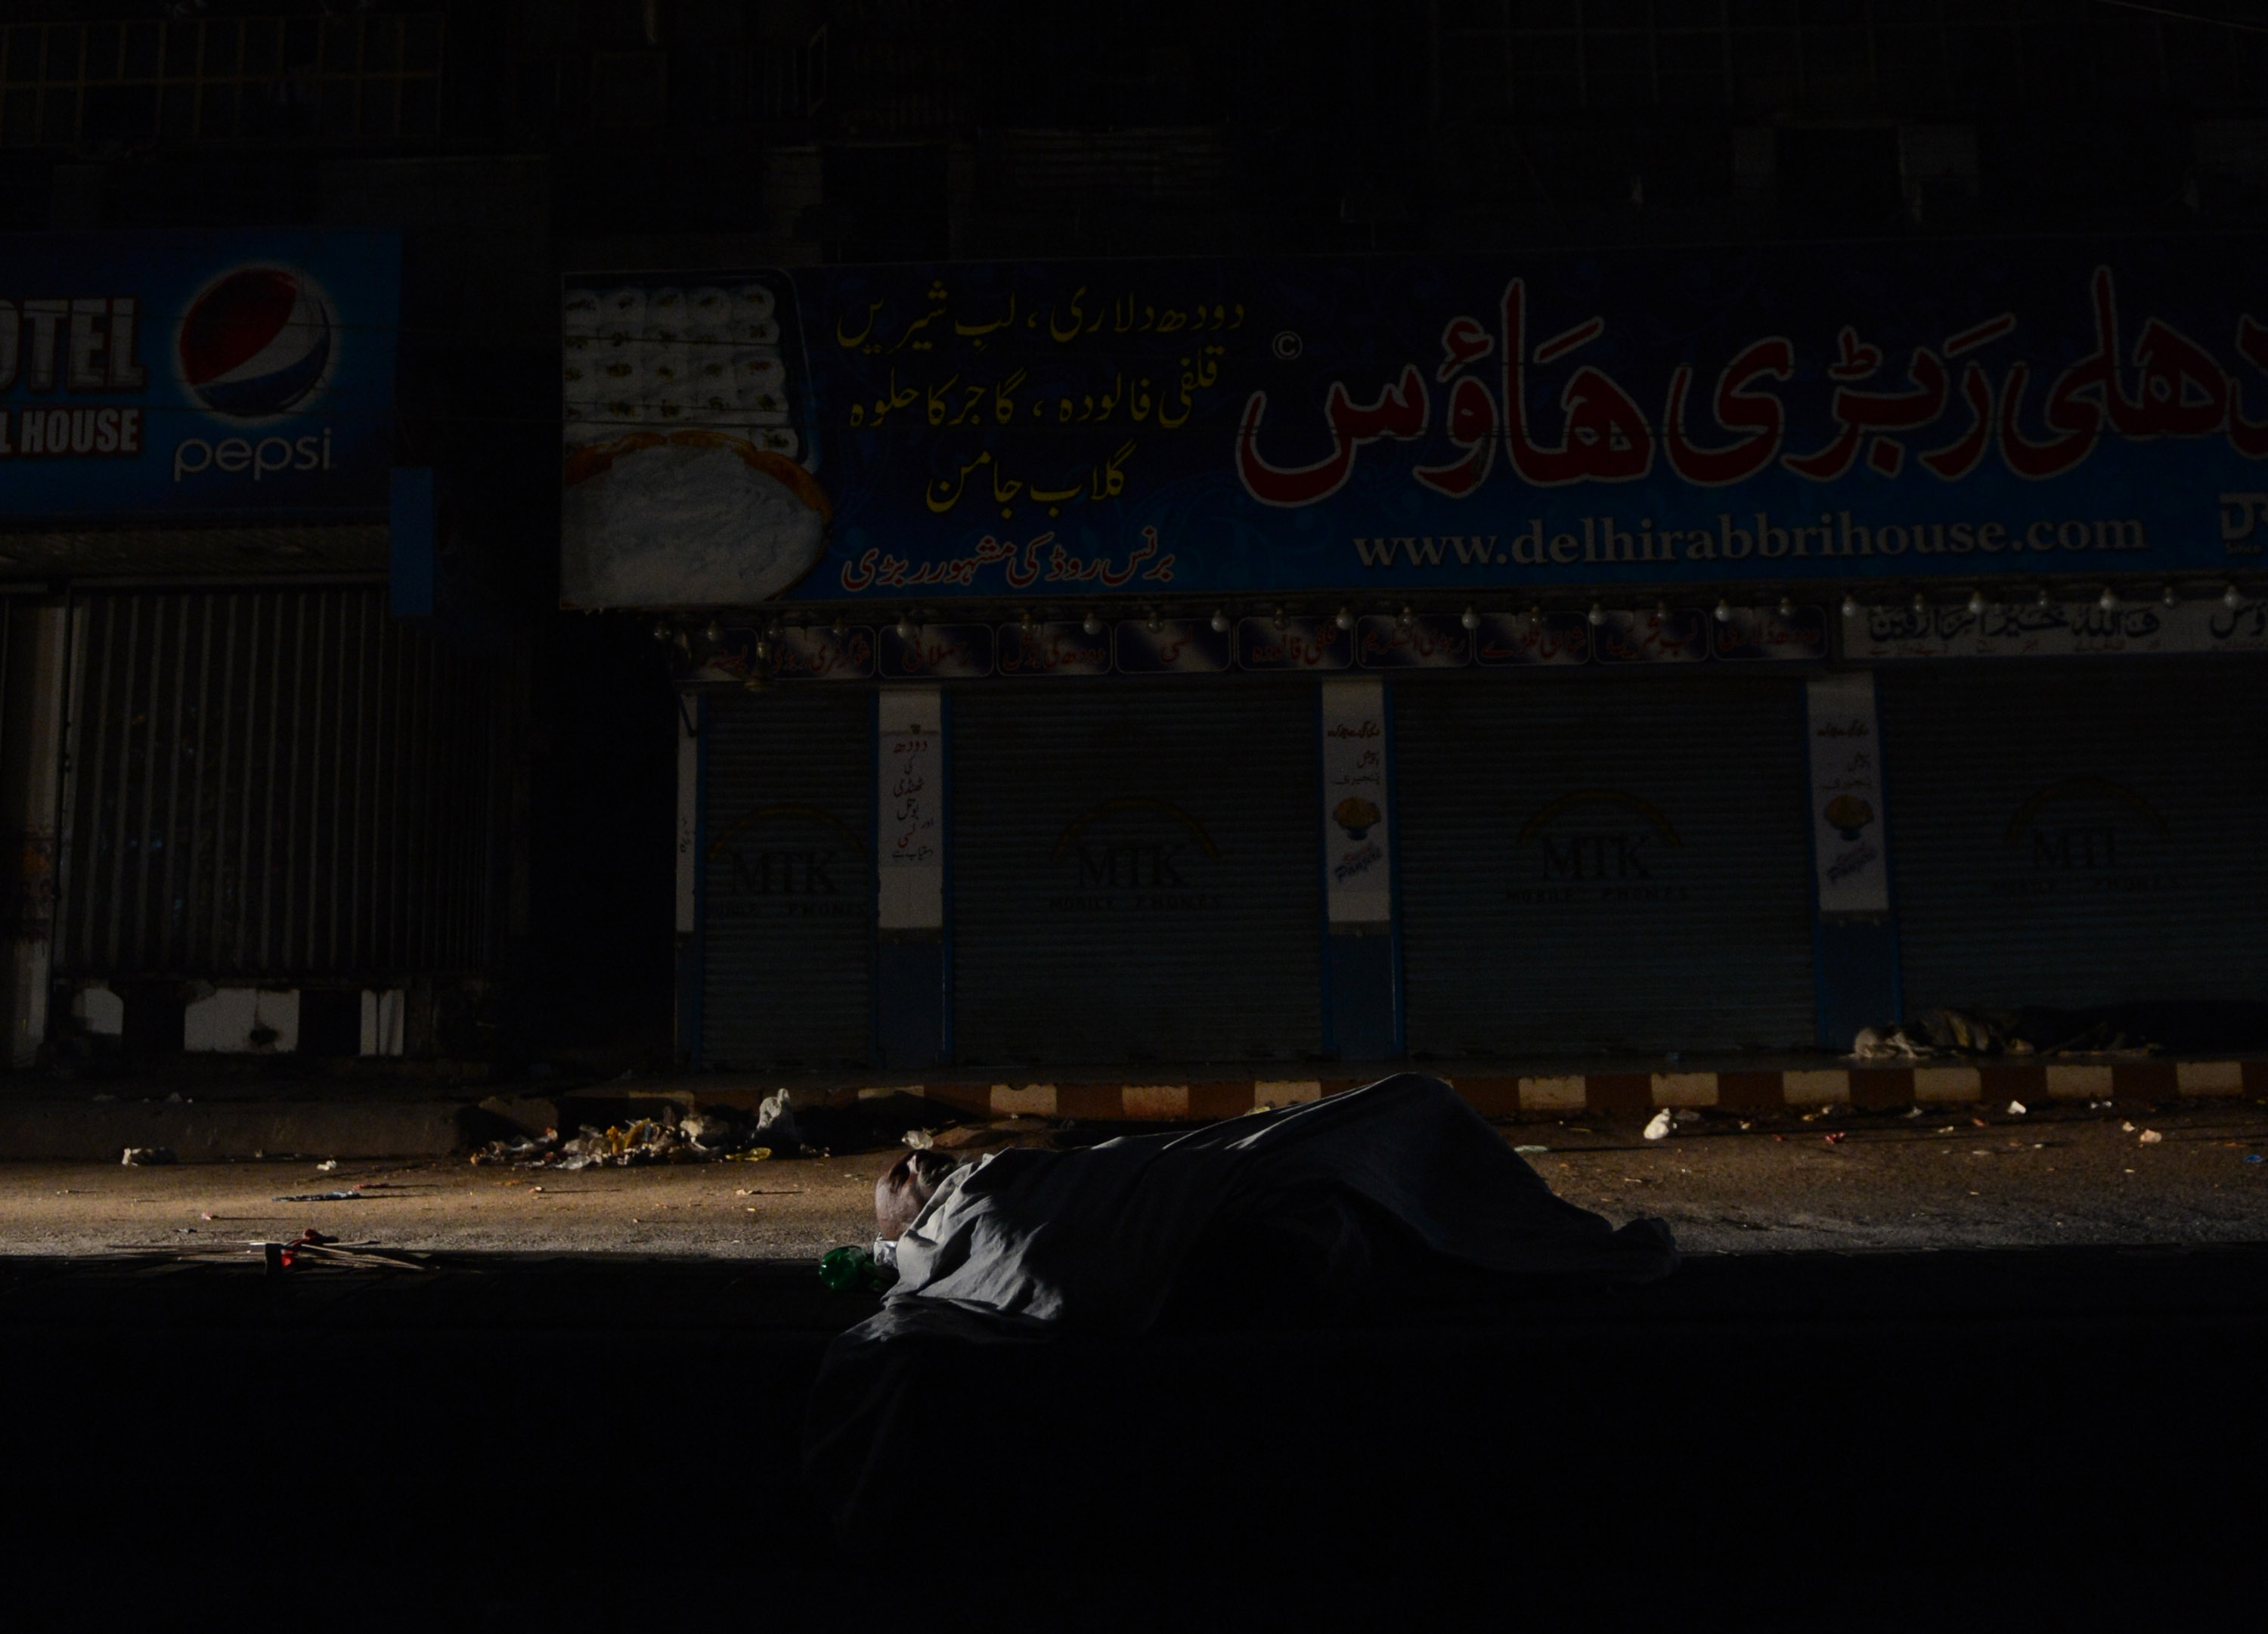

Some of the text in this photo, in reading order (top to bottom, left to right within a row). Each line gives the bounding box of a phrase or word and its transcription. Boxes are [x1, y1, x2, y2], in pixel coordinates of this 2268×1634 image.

[836, 278, 950, 354] شیریں
[1154, 302, 1246, 333] دودھ
[849, 367, 923, 428] حلوہ
[926, 372, 960, 426] کا
[947, 367, 1028, 426] گاجر
[1157, 344, 1226, 429] قلفی
[20, 408, 140, 454] HOUSE
[173, 426, 331, 484] pepsi
[925, 437, 1138, 520] گلاب جامن
[841, 525, 1176, 591] برنس روڈ کی مشہور ربڑی
[1352, 510, 2149, 571] www.delhirabbrihouse.com
[732, 851, 836, 895] MTK
[1077, 844, 1188, 888] MTK
[1542, 836, 1651, 879] MTK
